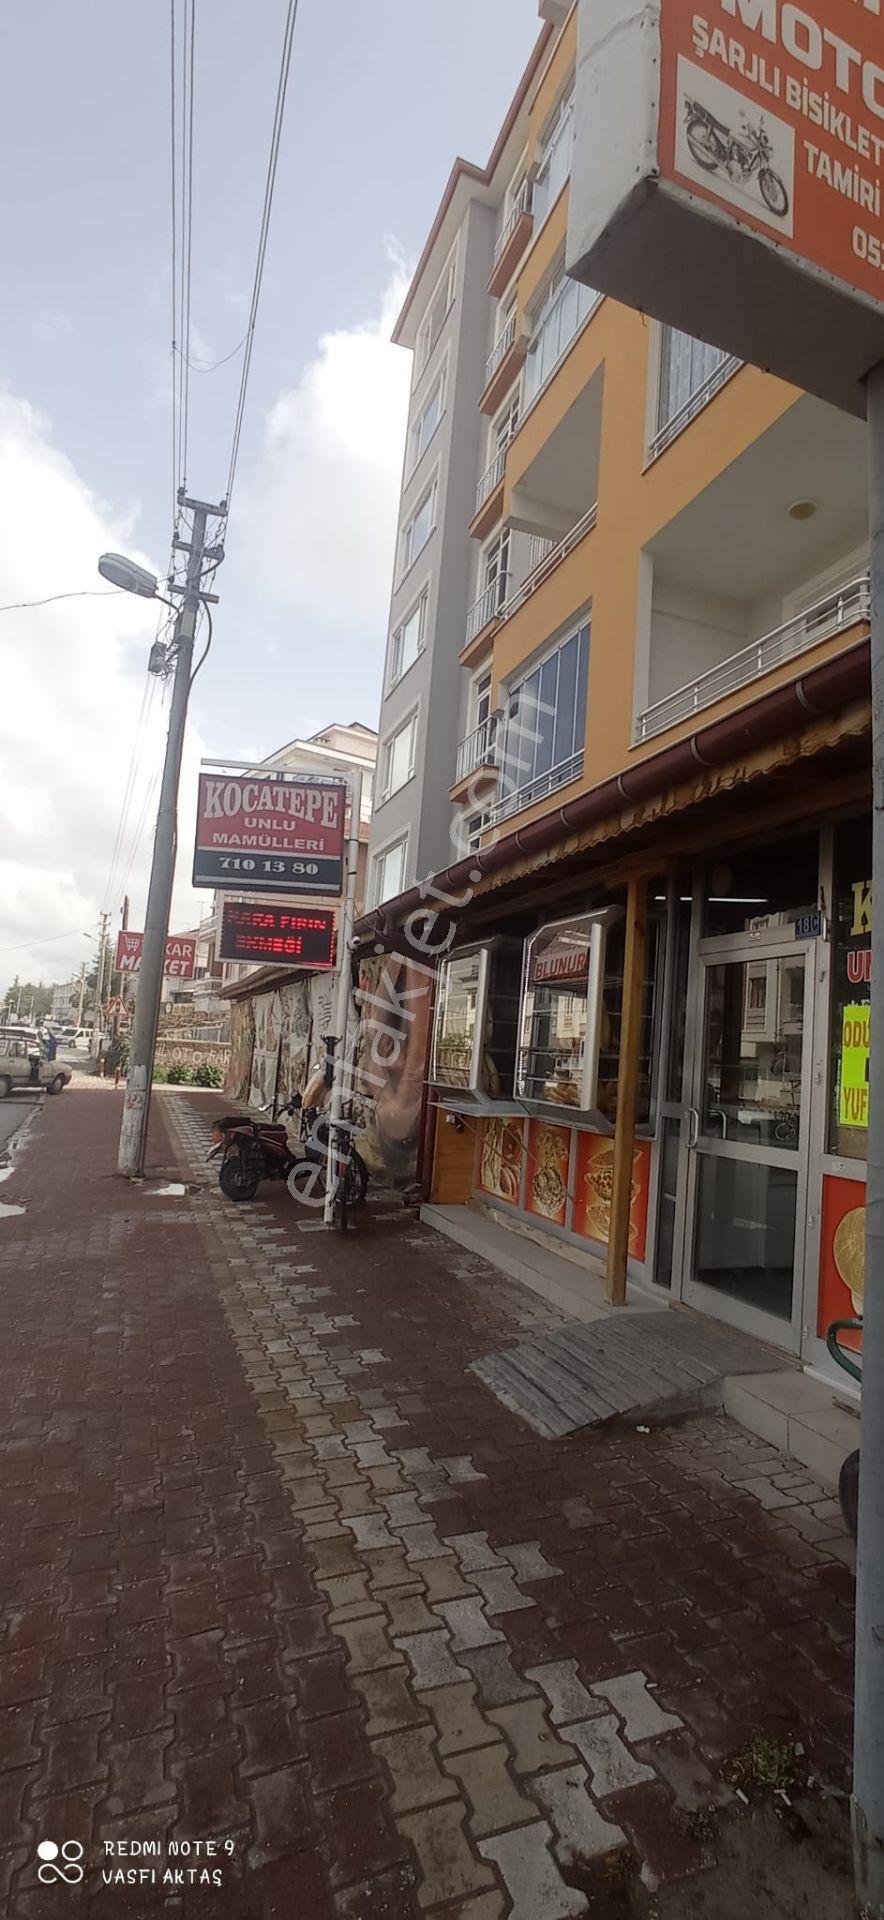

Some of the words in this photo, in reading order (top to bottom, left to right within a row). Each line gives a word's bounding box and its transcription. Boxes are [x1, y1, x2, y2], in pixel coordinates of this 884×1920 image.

[692, 14, 780, 97] ŞARJLI
[786, 75, 884, 166] BİSİKLET
[803, 139, 880, 217] TAMİRİ
[203, 780, 338, 829] KOCATEPE
[244, 816, 296, 831] UNLU
[212, 832, 325, 851] MAMÜLLERİ
[219, 857, 256, 870] 710
[262, 860, 286, 873] 13
[292, 862, 319, 875] 80
